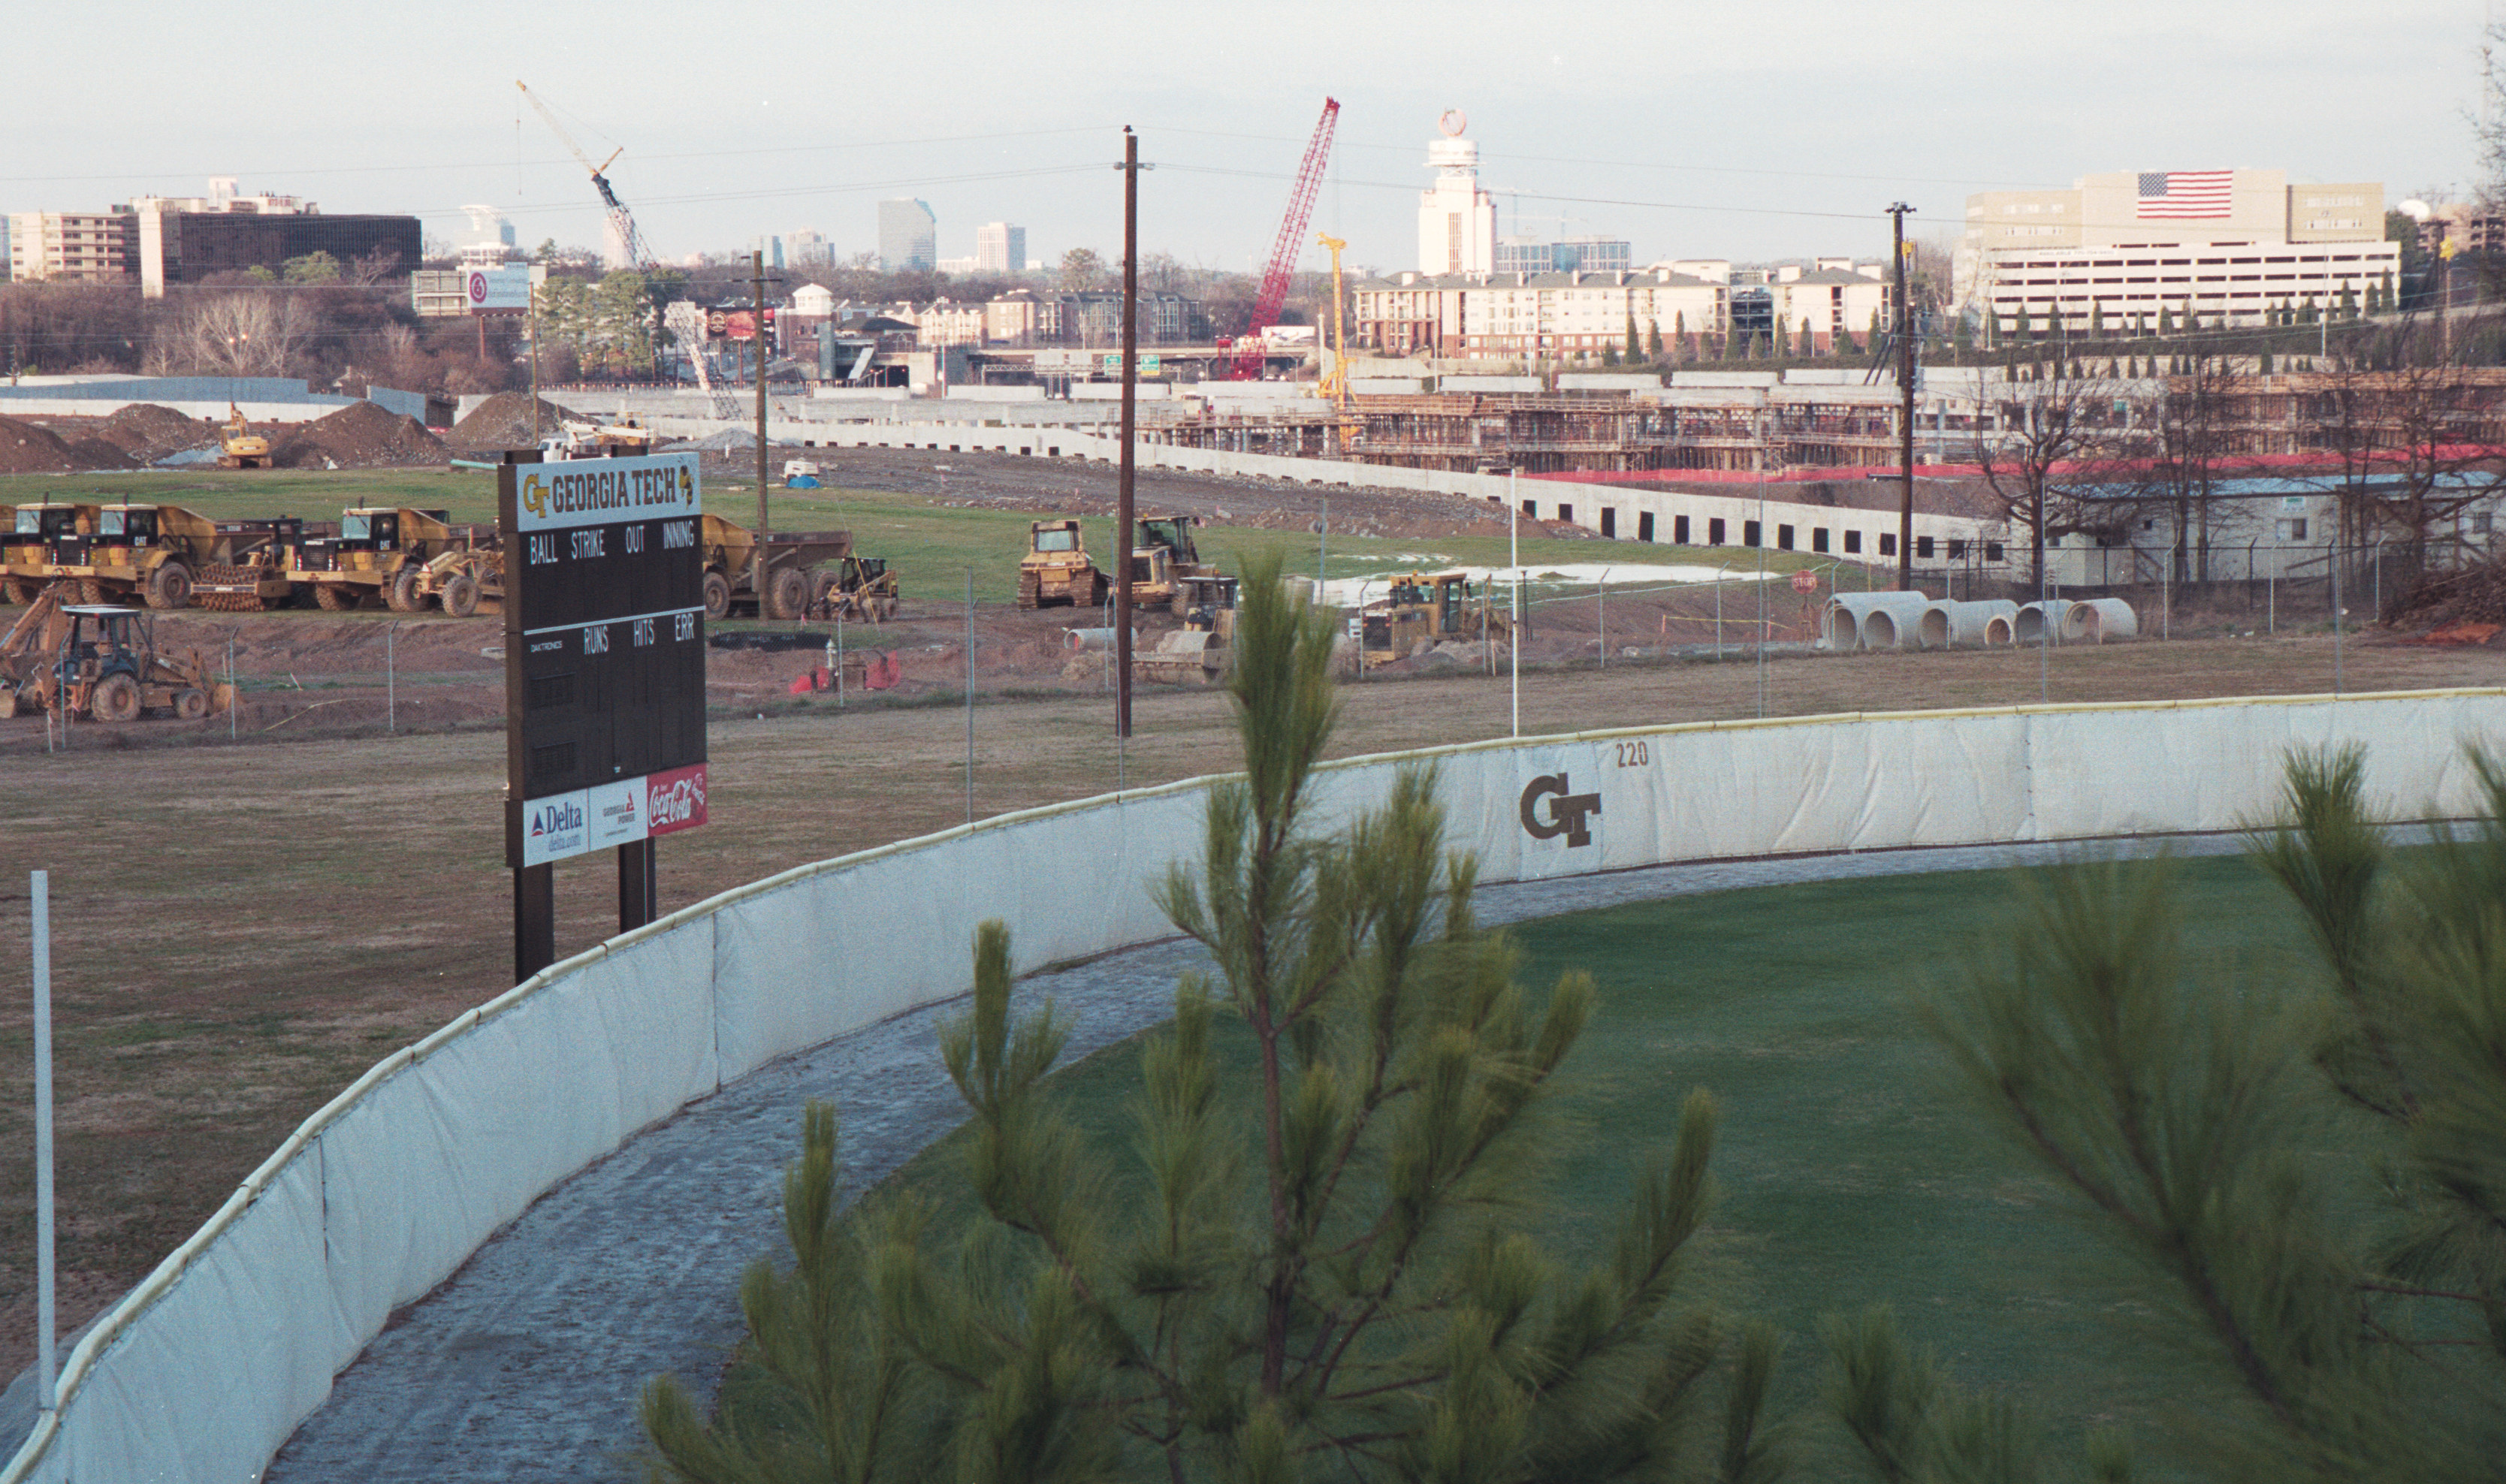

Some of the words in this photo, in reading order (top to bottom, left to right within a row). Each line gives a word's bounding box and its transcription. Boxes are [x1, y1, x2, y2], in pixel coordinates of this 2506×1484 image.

[552, 470, 630, 513] GEORGIA
[632, 466, 676, 505] TECH
[134, 535, 147, 547] CAT
[380, 540, 390, 550] CAT
[530, 534, 558, 565] BALL
[571, 529, 605, 560] STRIKE
[626, 525, 645, 553] OUT
[663, 520, 695, 549] INNING
[1793, 578, 1815, 587] STOP
[584, 624, 608, 655] RUNS
[634, 618, 654, 647] HITS
[675, 612, 694, 641] ERR
[1617, 740, 1649, 768] 220
[546, 801, 582, 834] Delta
[648, 779, 692, 828] Coca-Cola
[1520, 772, 1602, 849] GT
